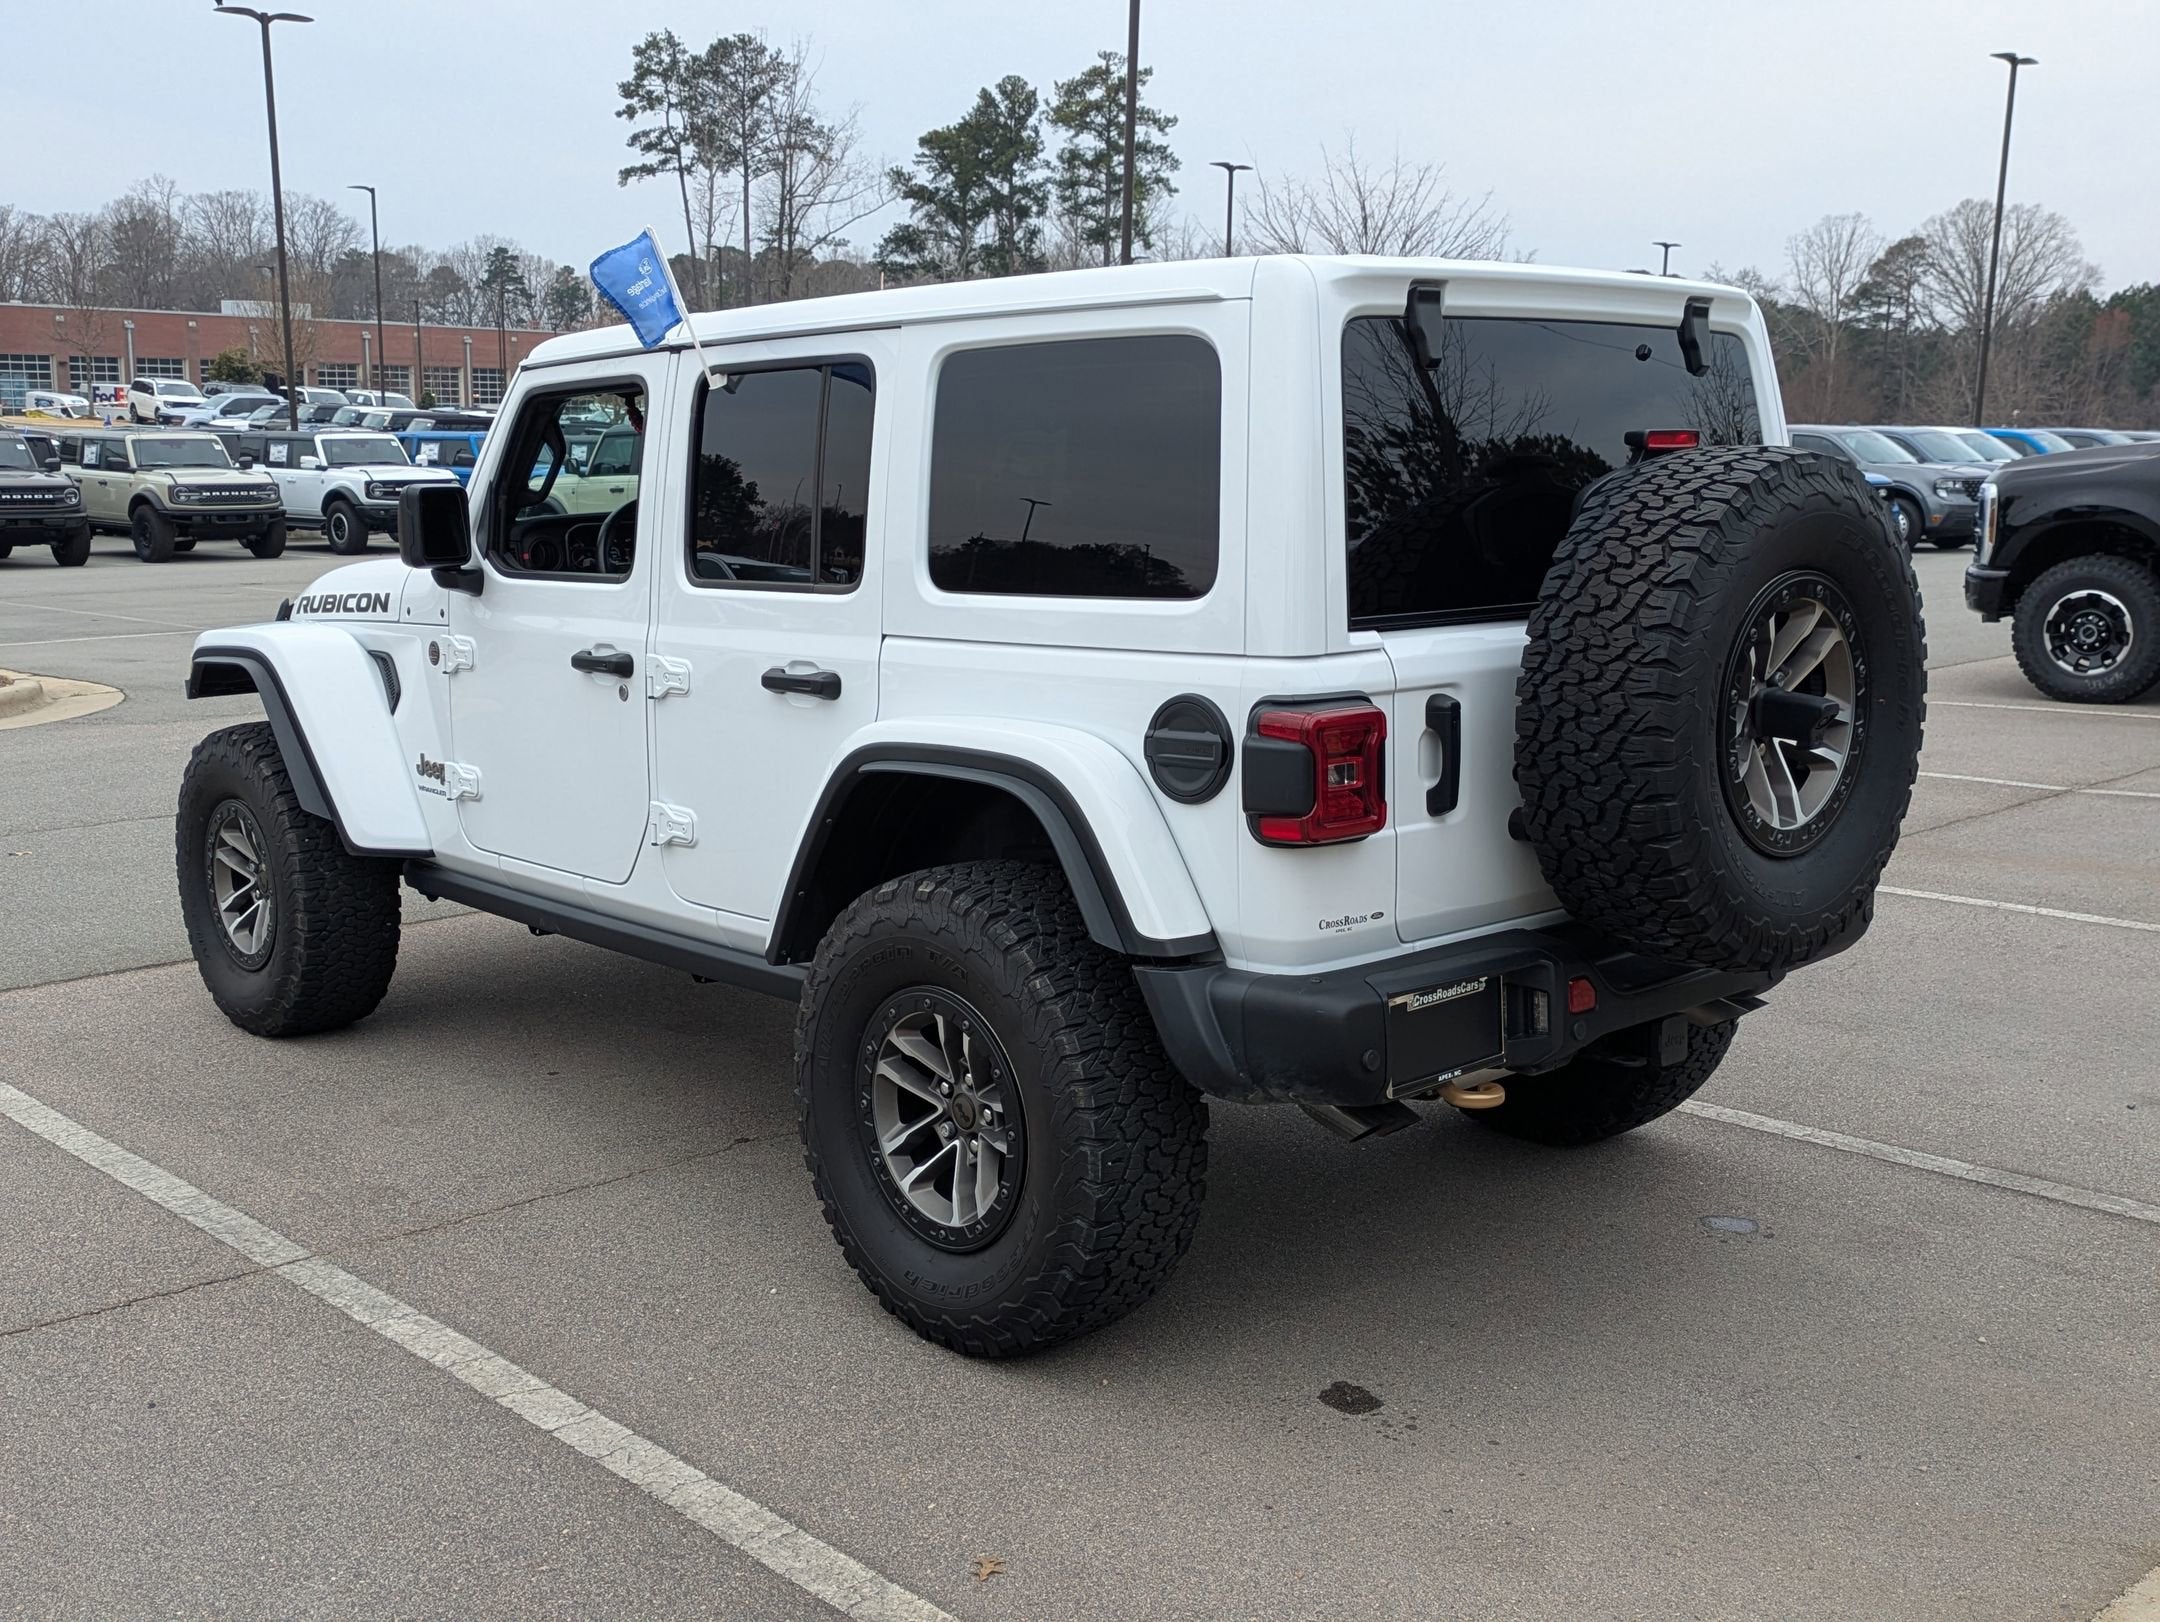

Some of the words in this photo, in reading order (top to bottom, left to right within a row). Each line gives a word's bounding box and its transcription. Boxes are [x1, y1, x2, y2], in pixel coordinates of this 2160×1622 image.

[296, 592, 391, 615] RUBICON
[416, 752, 446, 786] Jeep
[1413, 980, 1480, 1008] CrossRoadsCars
